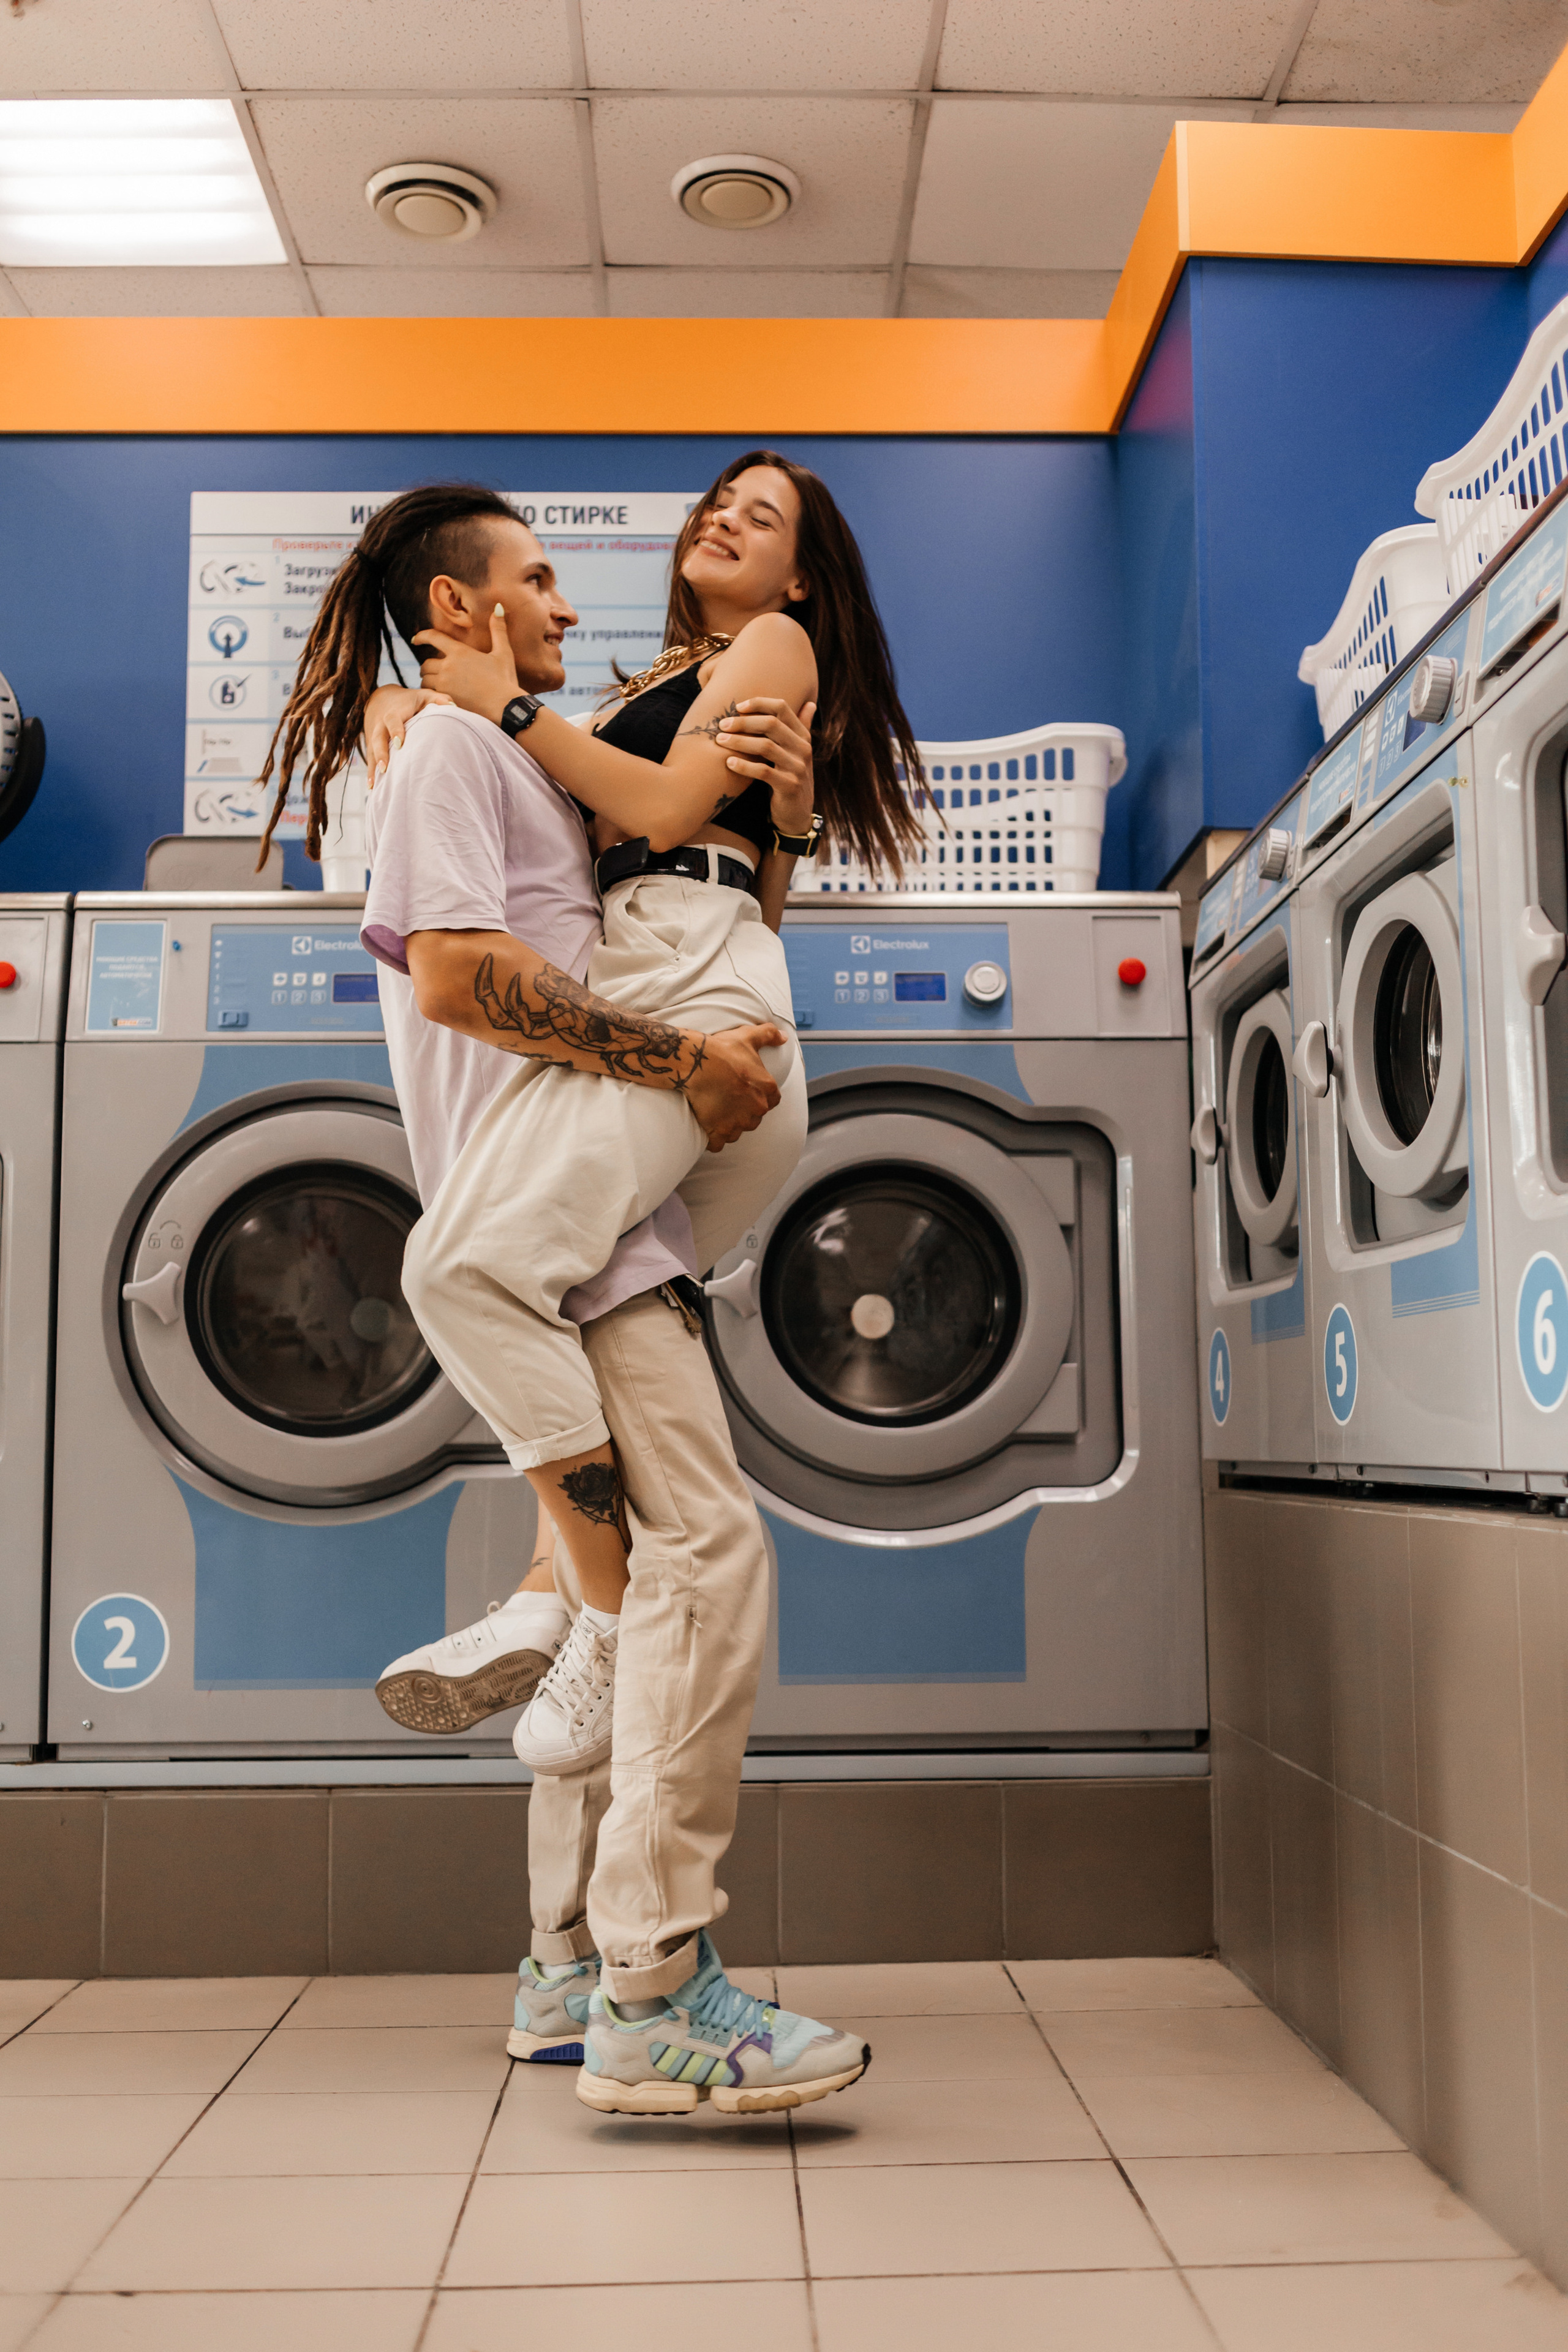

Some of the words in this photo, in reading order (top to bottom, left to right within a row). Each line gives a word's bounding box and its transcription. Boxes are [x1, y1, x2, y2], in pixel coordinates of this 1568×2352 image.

[545, 505, 628, 524] СТИРКЕ
[873, 940, 929, 949] Electrolux
[295, 992, 303, 1001] 2
[315, 992, 322, 1001] 3
[858, 992, 865, 1001] 2
[877, 992, 884, 1001] 3
[1533, 1289, 1556, 1375] 6
[1215, 1351, 1224, 1401] 4
[1335, 1331, 1348, 1398] 5
[104, 1616, 137, 1669] 2
